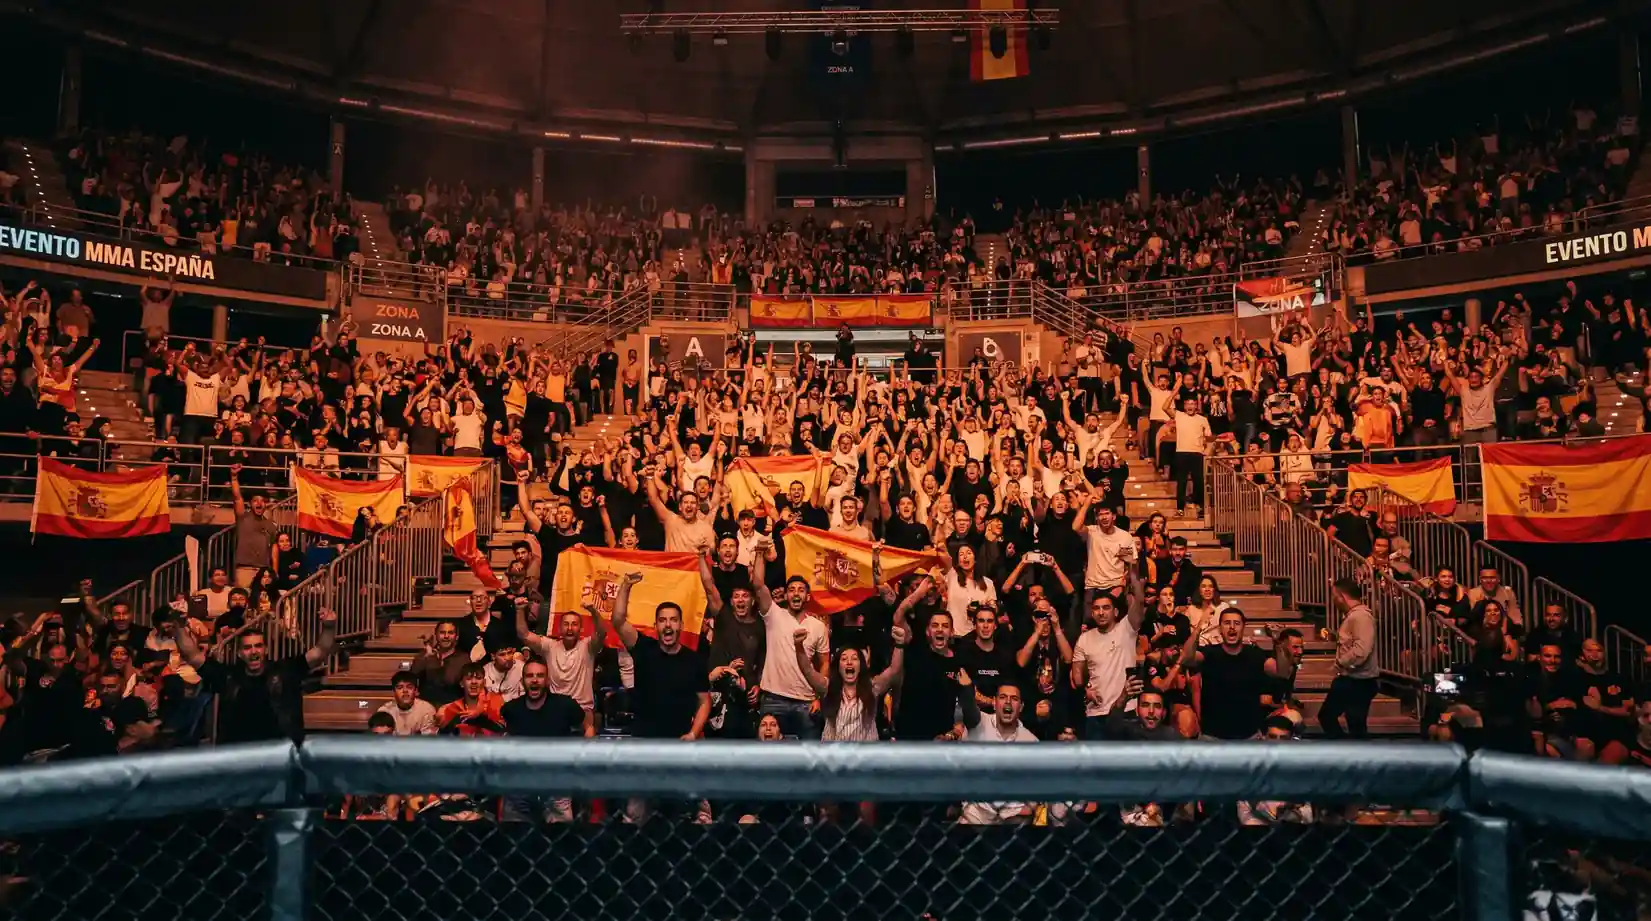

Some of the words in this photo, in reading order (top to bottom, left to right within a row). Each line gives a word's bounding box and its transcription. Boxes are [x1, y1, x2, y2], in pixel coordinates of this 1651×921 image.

[0, 225, 80, 259] EVENTO
[85, 241, 135, 268] MMA
[140, 251, 215, 280] ESPAÑA
[1546, 231, 1627, 263] EVENTO
[1632, 225, 1651, 249] M
[376, 304, 420, 320] ZONA
[371, 323, 412, 338] ZONA
[414, 327, 425, 338] A
[684, 336, 704, 357] A
